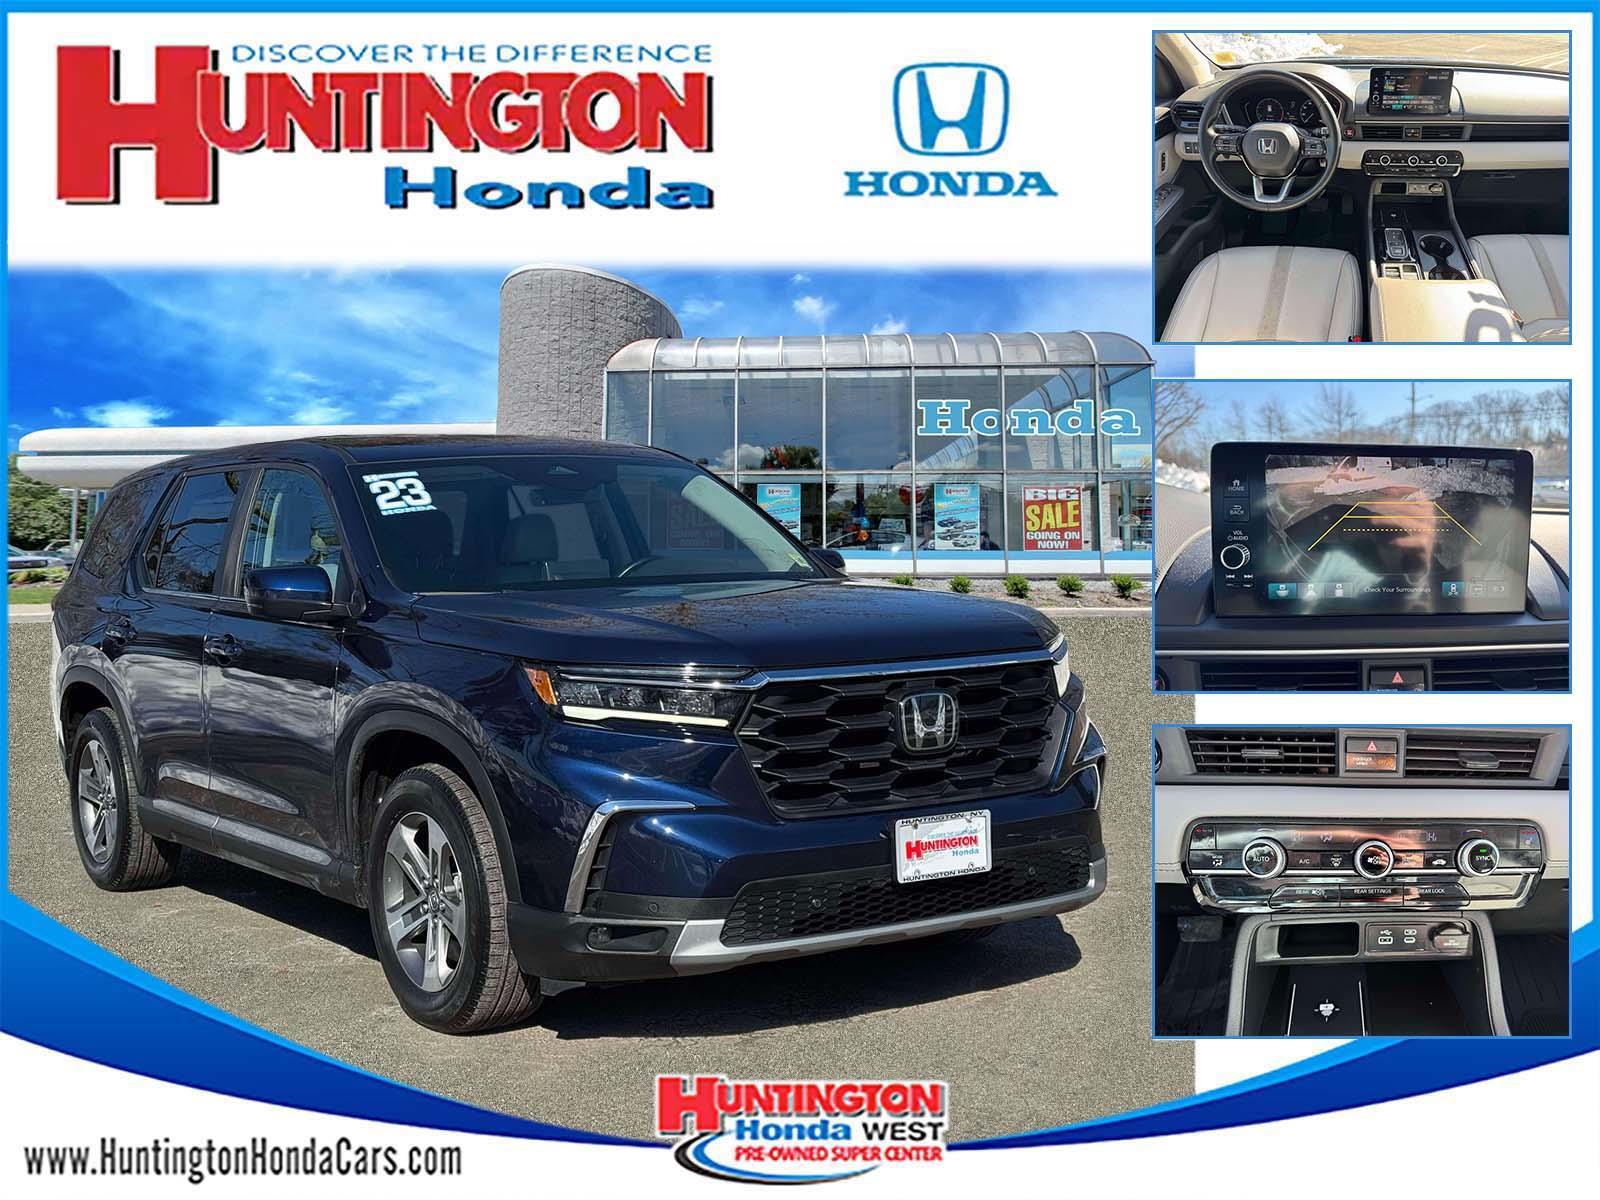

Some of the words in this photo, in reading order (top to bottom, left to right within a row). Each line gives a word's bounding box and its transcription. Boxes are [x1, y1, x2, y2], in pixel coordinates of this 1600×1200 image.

[917, 399, 1141, 436] Honda
[369, 477, 432, 511] 23
[1025, 488, 1079, 501] BIG
[1025, 501, 1080, 531] SALE
[1026, 531, 1061, 540] GOING
[1064, 531, 1080, 540] ON
[1037, 540, 1069, 549] NOW!
[905, 835, 978, 860] HUNTINGTON
[952, 848, 979, 857] Honda
[903, 871, 956, 882] HUNTINGTON
[958, 866, 986, 874] HONDA
